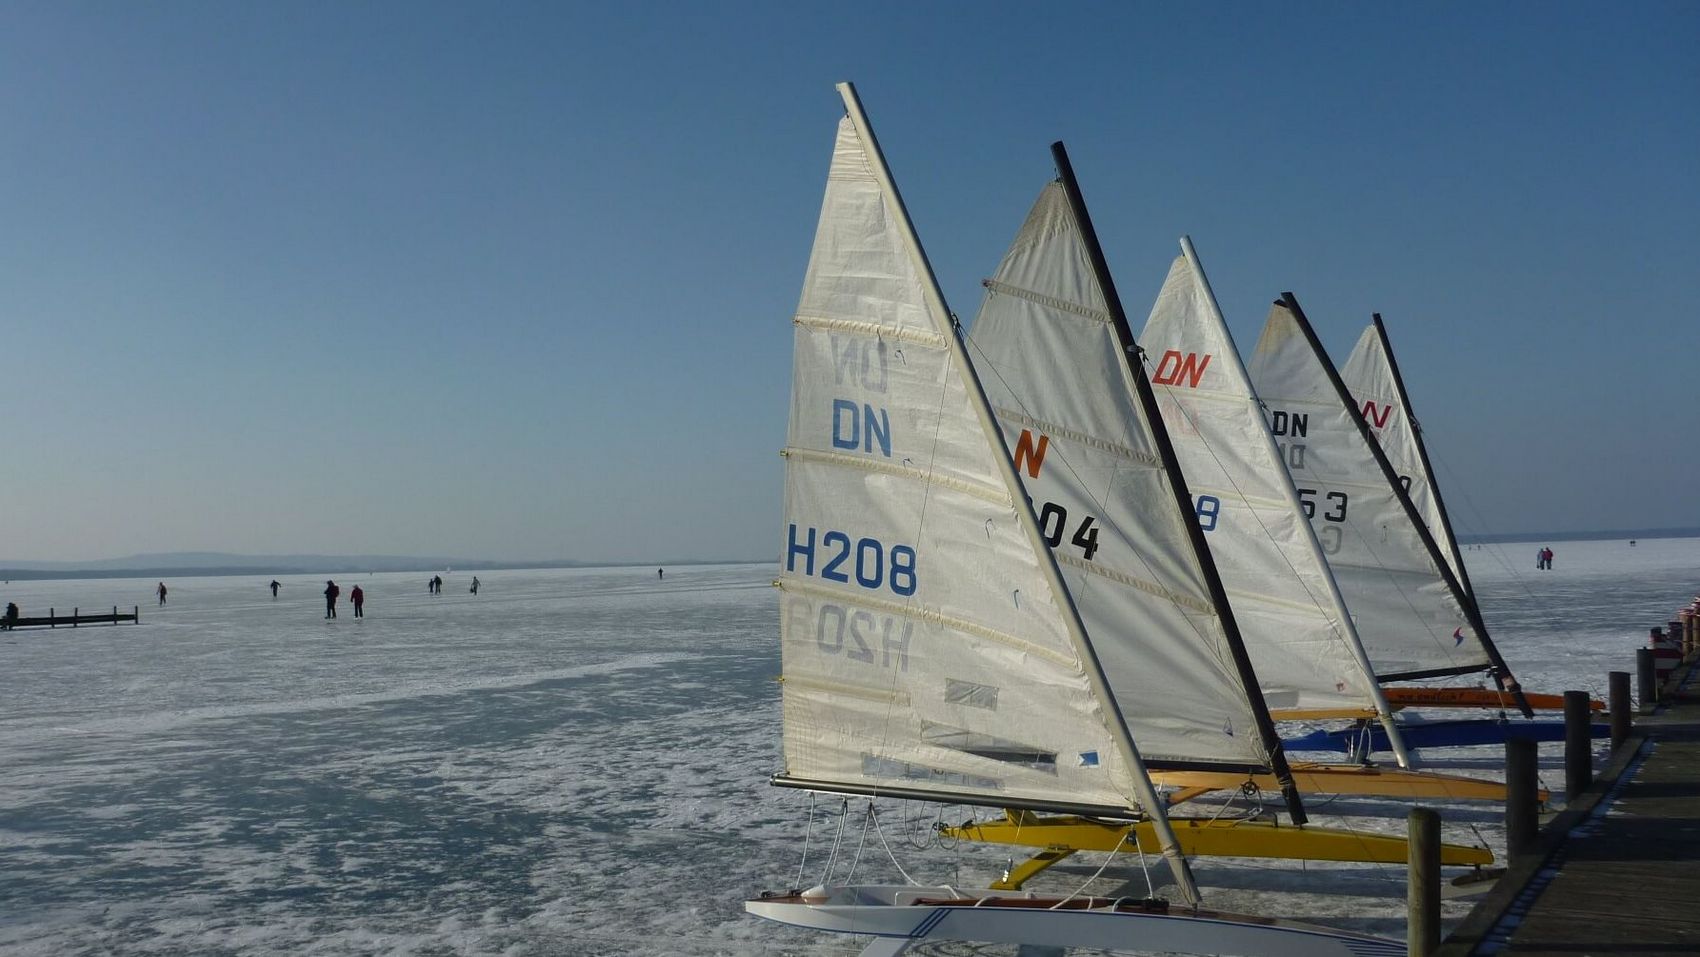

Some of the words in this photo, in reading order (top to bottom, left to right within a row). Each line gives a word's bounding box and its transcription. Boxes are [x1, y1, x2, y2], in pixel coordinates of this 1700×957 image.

[1152, 350, 1212, 389] DN
[833, 398, 891, 458] DN
[1273, 410, 1308, 438] DN
[787, 523, 917, 597] H208
[1036, 500, 1099, 560] 04
